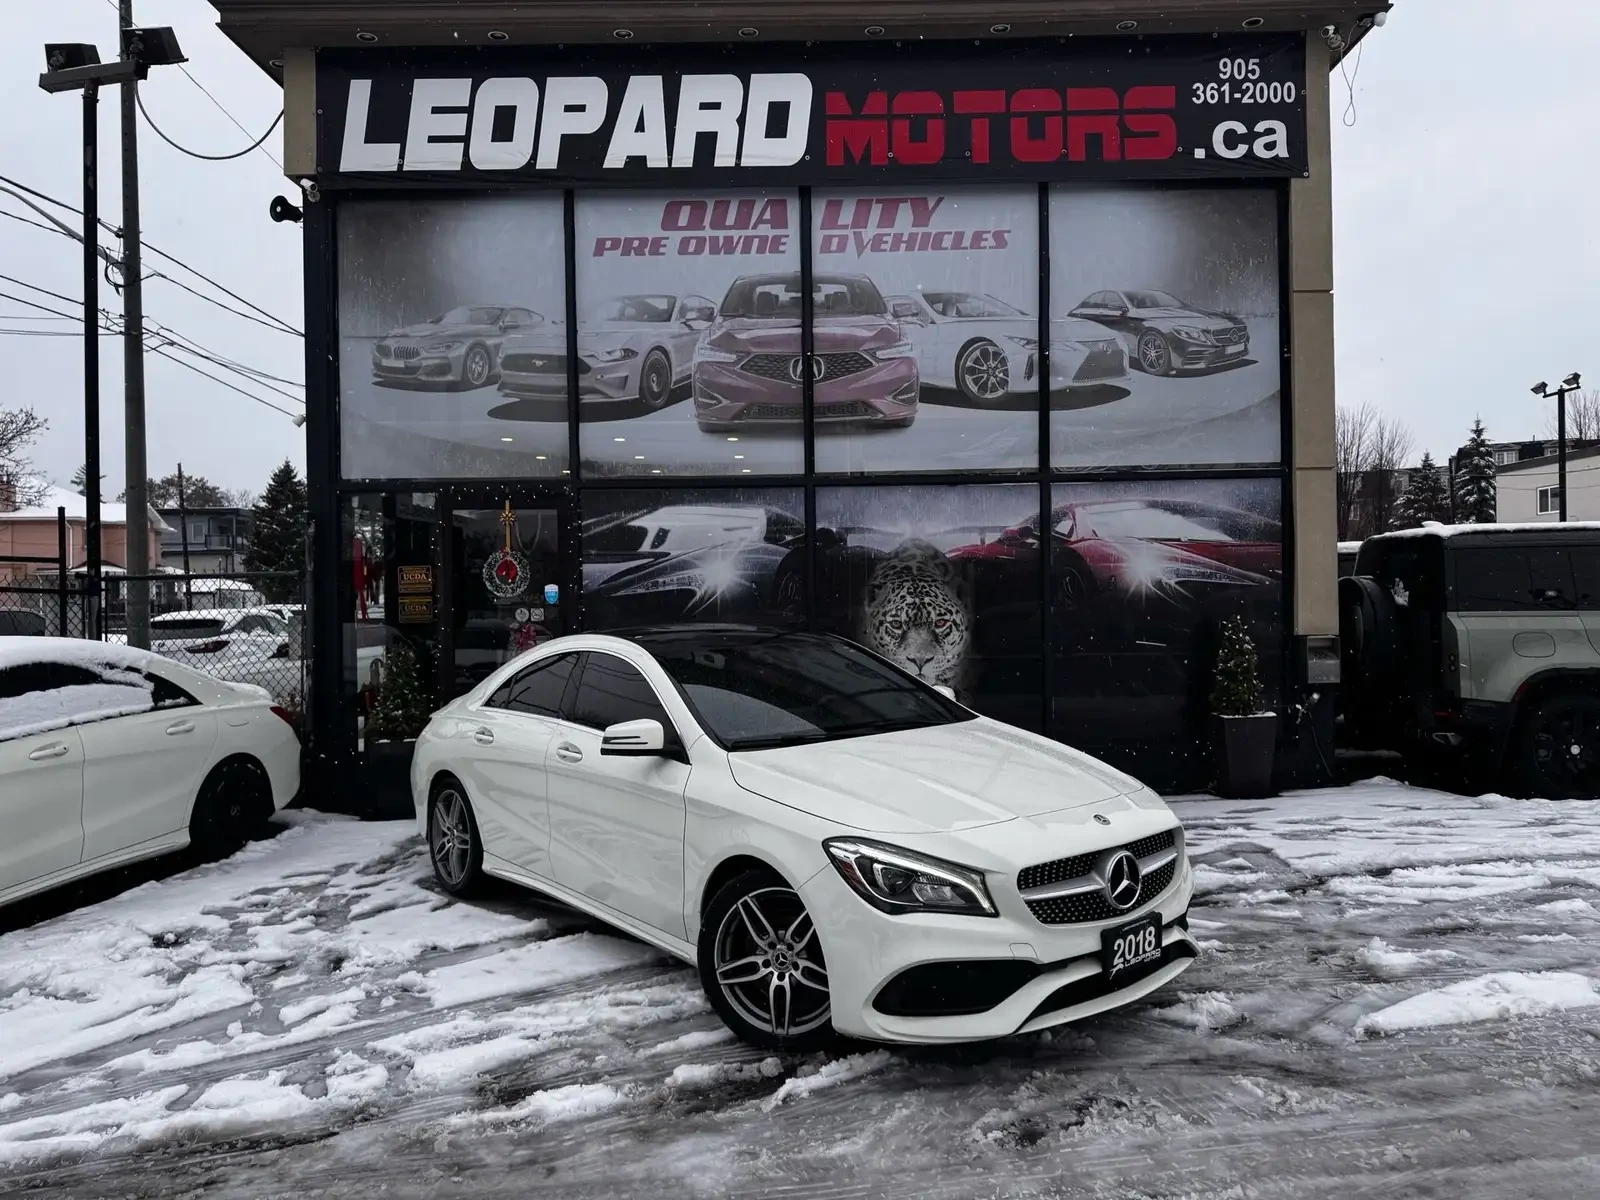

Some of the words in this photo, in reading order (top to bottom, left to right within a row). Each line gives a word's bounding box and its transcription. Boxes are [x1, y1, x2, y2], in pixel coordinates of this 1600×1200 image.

[1218, 57, 1260, 80] 905
[1191, 81, 1296, 105] 361-2000
[339, 72, 813, 172] LEOPARD
[825, 86, 1178, 166] MOTORS
[1194, 118, 1290, 159] .ca
[593, 236, 670, 257] PRE
[1113, 926, 1156, 966] 2018
